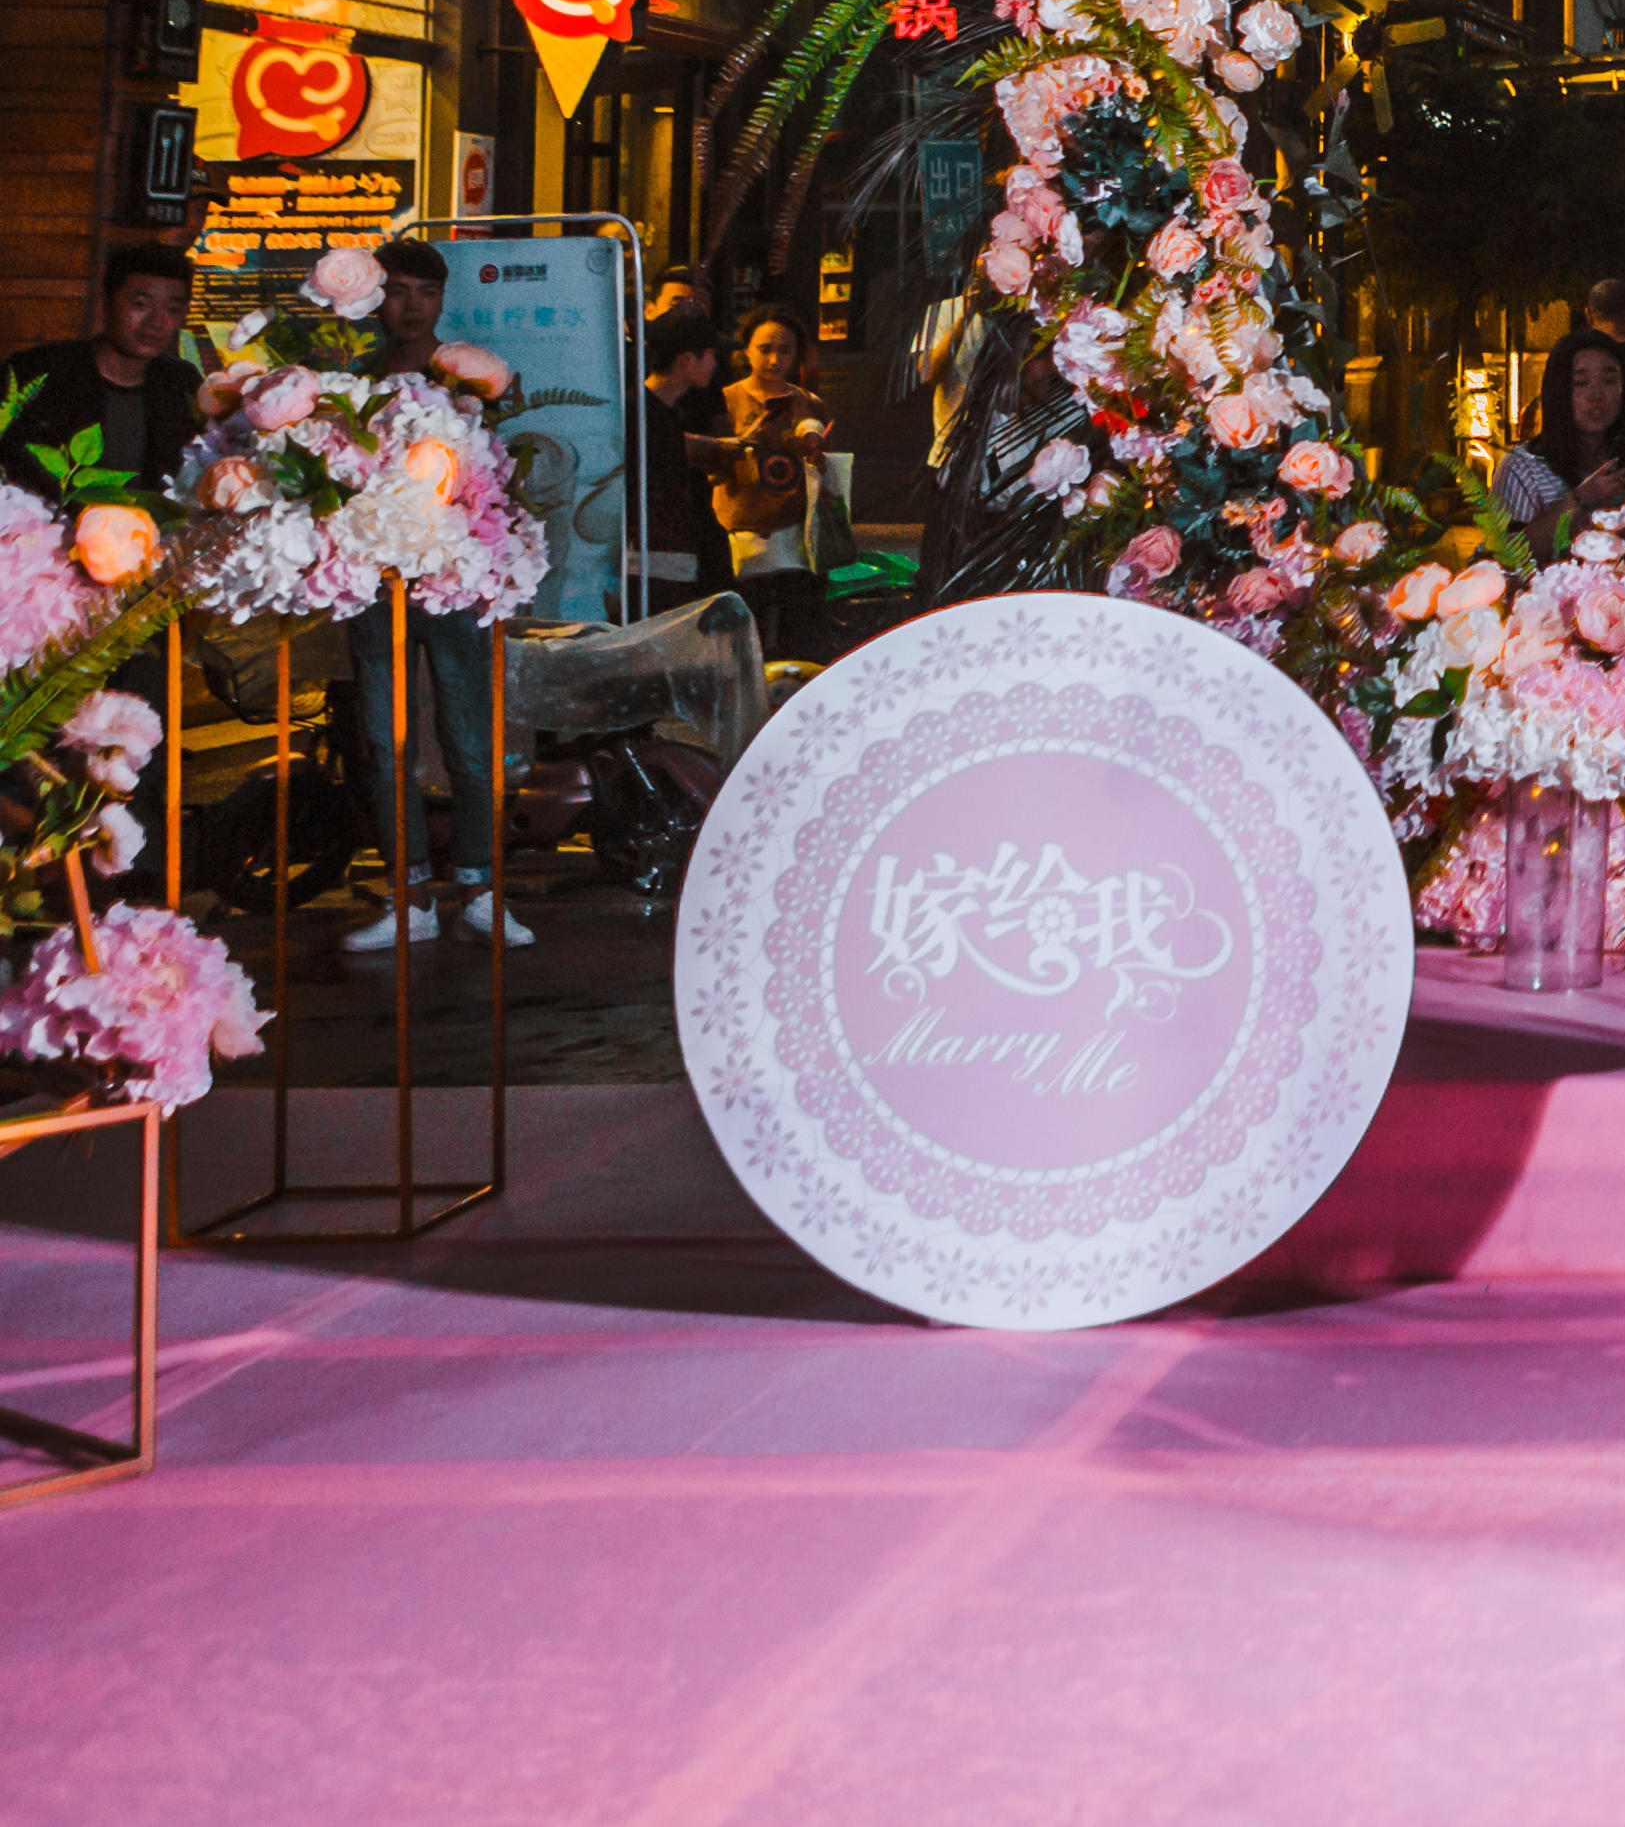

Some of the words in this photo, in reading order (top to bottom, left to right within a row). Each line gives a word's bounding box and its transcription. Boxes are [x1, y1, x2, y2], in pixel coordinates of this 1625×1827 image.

[864, 840, 1235, 1020] 嫁给我
[862, 1006, 1063, 1083] Marry
[1032, 1028, 1141, 1096] Me
